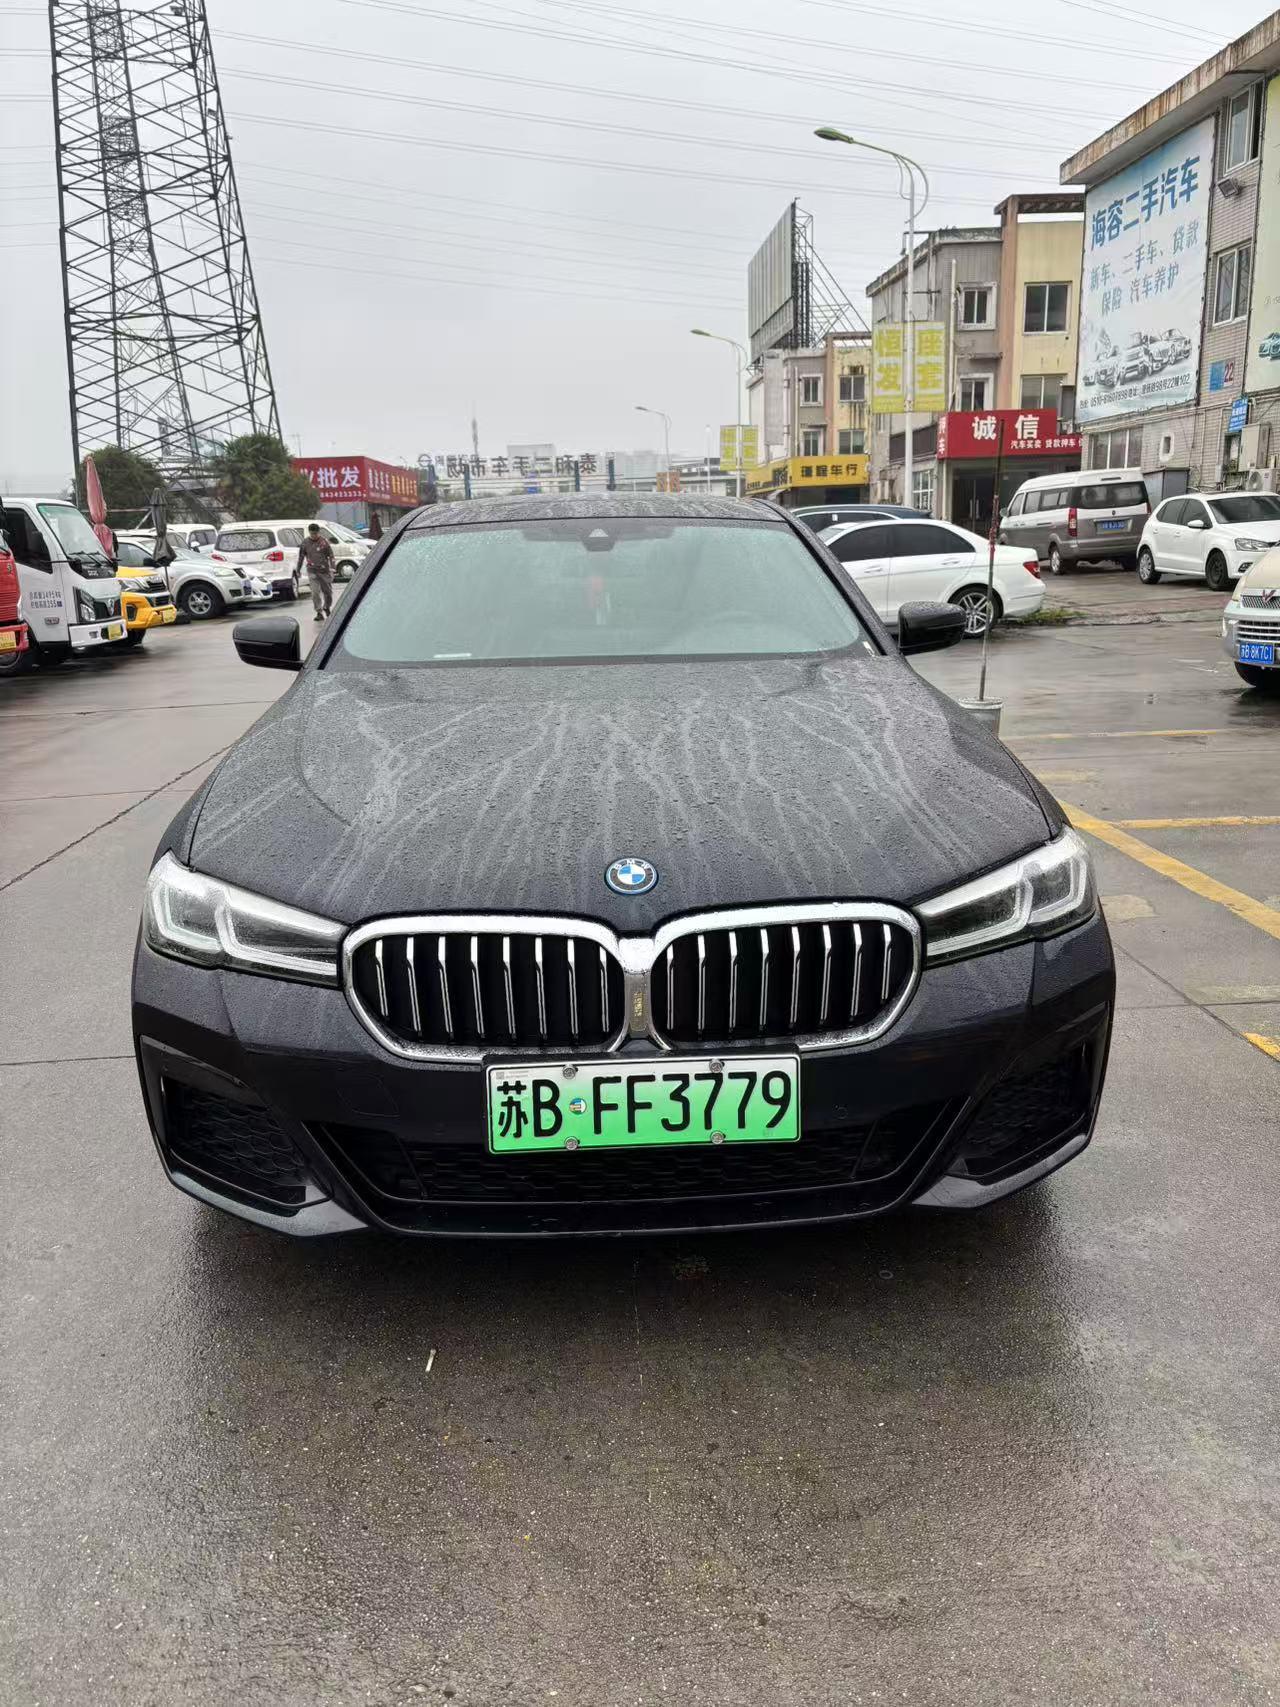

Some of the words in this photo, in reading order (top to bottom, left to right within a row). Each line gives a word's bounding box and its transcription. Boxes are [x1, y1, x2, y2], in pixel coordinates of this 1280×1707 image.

[1091, 156, 1200, 251] 海容二手汽车
[972, 414, 1039, 440] 诚信
[1010, 439, 1042, 449] 汽车买卖
[1045, 438, 1076, 449] 贷款押车
[496, 1078, 563, 1139] 苏B
[592, 1070, 792, 1135] FF3779
